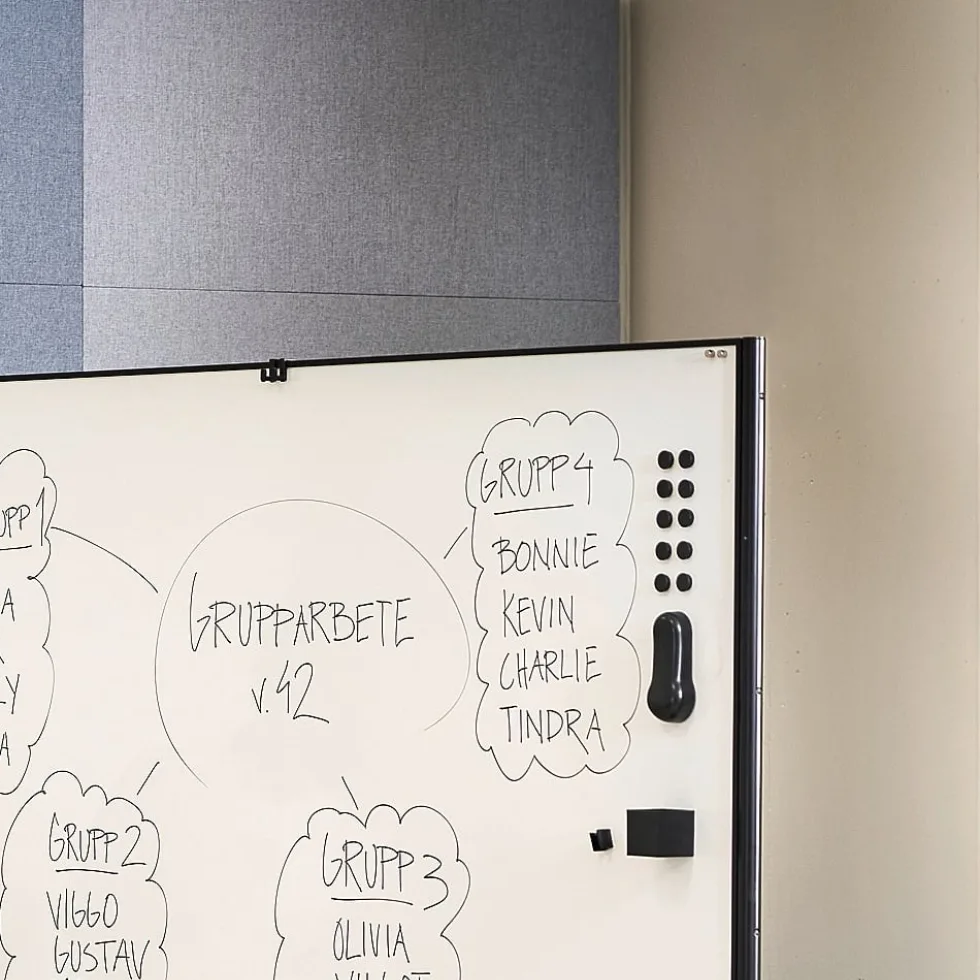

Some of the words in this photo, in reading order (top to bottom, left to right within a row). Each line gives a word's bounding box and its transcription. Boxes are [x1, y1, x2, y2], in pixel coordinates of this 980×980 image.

[480, 454, 570, 504] GRUPP
[573, 452, 594, 506] 4
[35, 486, 46, 547] 1
[491, 533, 600, 575] BONNIE
[189, 571, 415, 653] GRUPPARBETE
[502, 588, 575, 638] KEVIN
[499, 646, 603, 691] CHARLIE
[498, 705, 606, 756] TINDRA
[48, 811, 119, 864] GRUPP
[120, 824, 148, 868] 2
[322, 831, 415, 893] GRUPP
[422, 853, 450, 912] 3
[45, 887, 119, 931] VIGGO
[53, 934, 151, 980] GUSTAV
[332, 917, 411, 964] OLIVIA
